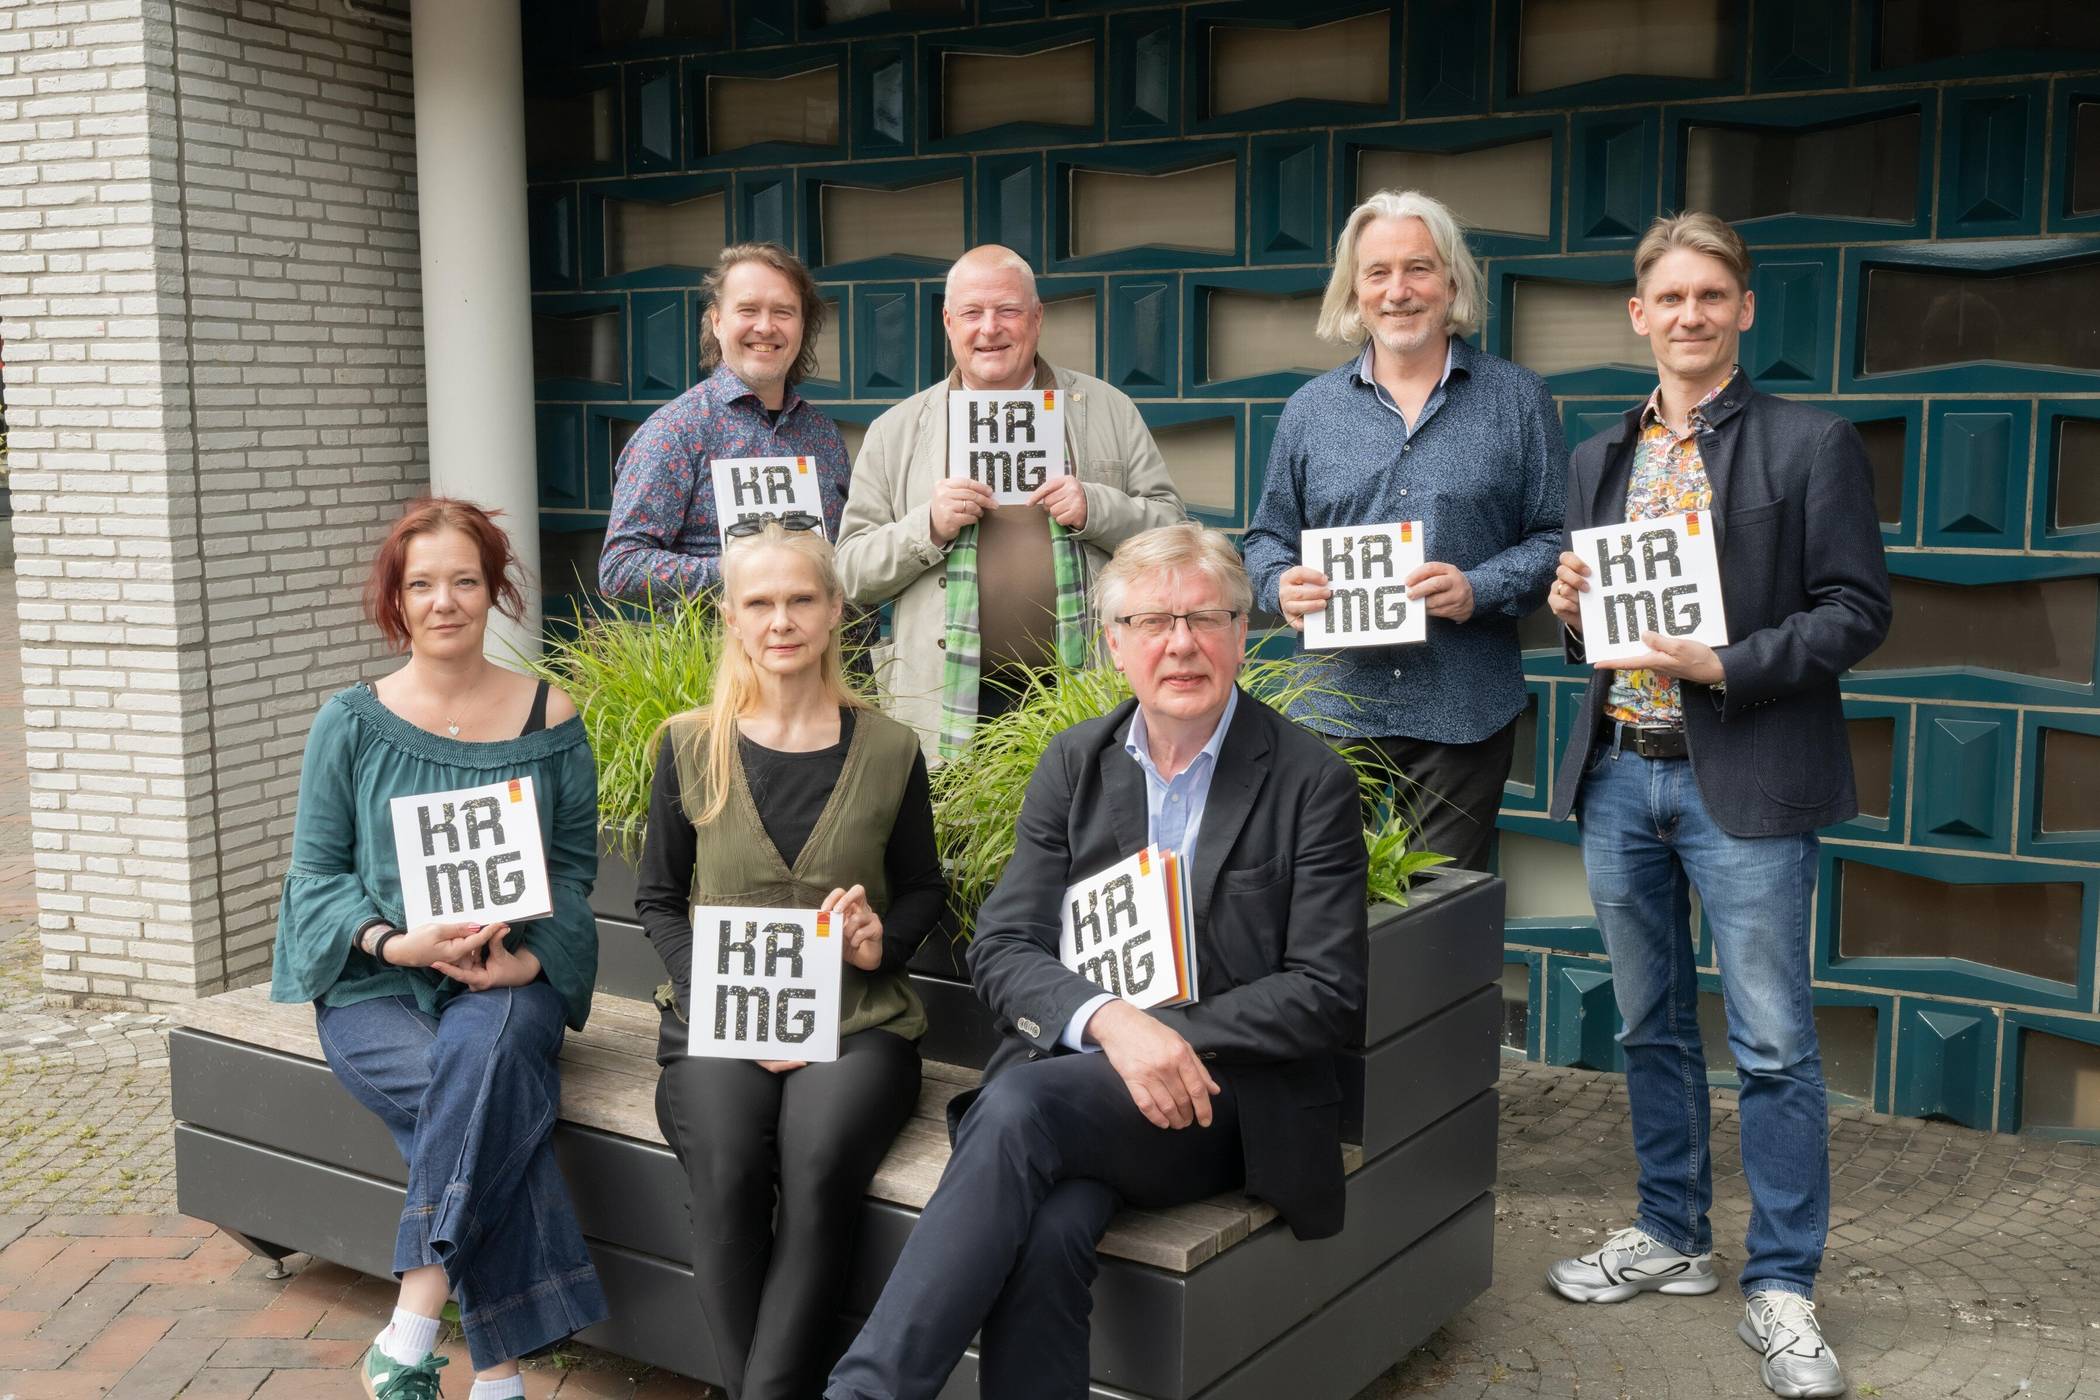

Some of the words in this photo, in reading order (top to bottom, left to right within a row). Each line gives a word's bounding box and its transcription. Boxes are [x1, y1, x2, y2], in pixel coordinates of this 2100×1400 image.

[969, 401, 1035, 443] KR
[731, 466, 796, 506] KR
[969, 450, 1046, 492] MG
[1322, 534, 1393, 581] KR
[1596, 528, 1682, 587] KR
[1325, 585, 1406, 634] MG
[1603, 583, 1702, 645] MG
[417, 796, 505, 856] KR
[425, 850, 526, 916] MG
[1072, 873, 1138, 955] KR
[717, 920, 805, 978] KR
[714, 984, 817, 1043] MG
